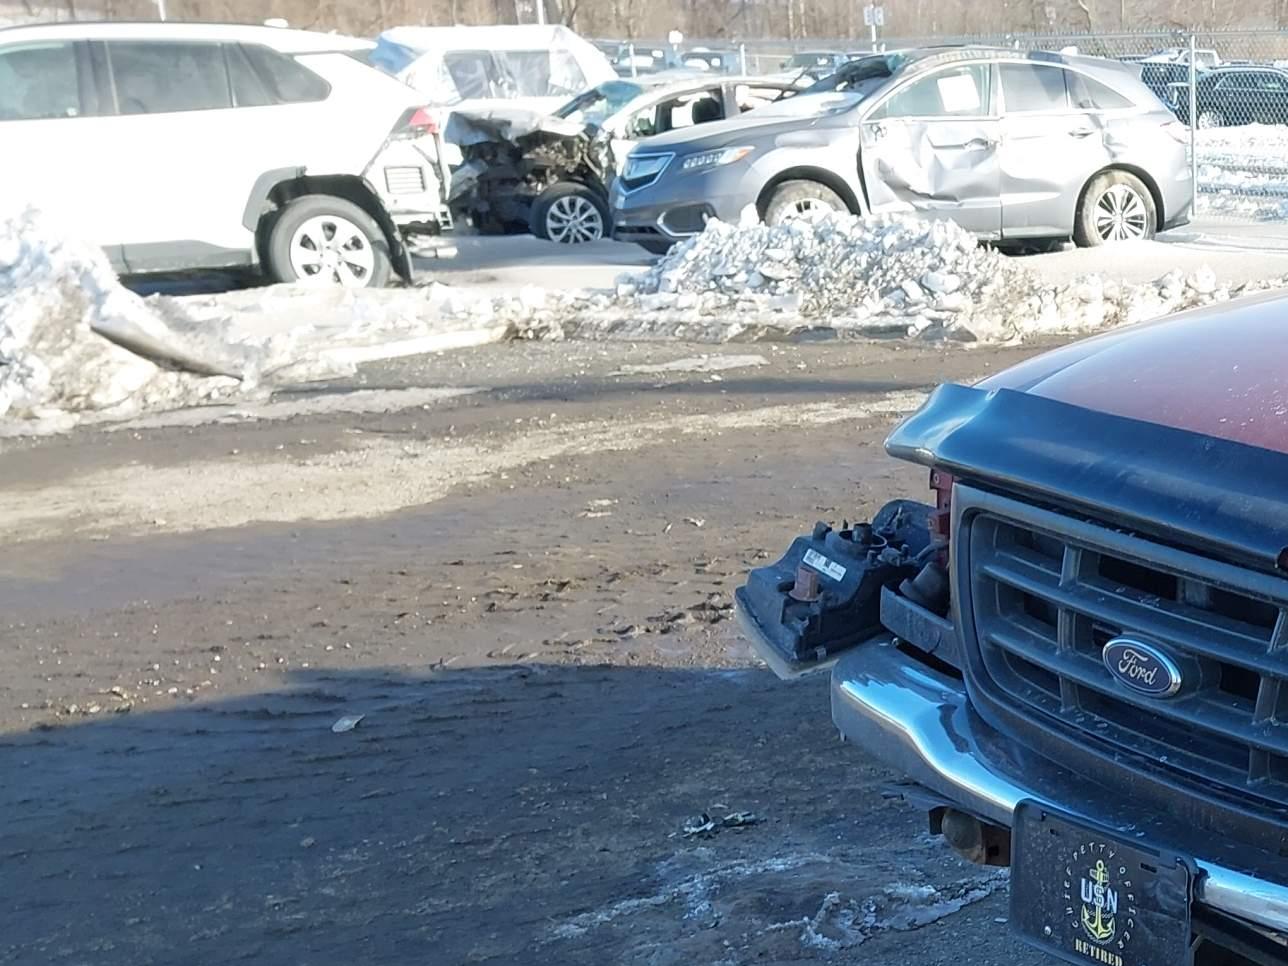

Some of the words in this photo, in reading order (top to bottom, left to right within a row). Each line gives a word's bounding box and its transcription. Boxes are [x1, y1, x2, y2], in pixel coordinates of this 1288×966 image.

[1118, 648, 1158, 686] Ford
[1072, 841, 1116, 861] PETTY
[1117, 866, 1136, 949] OFFICER
[1080, 877, 1118, 914] USN
